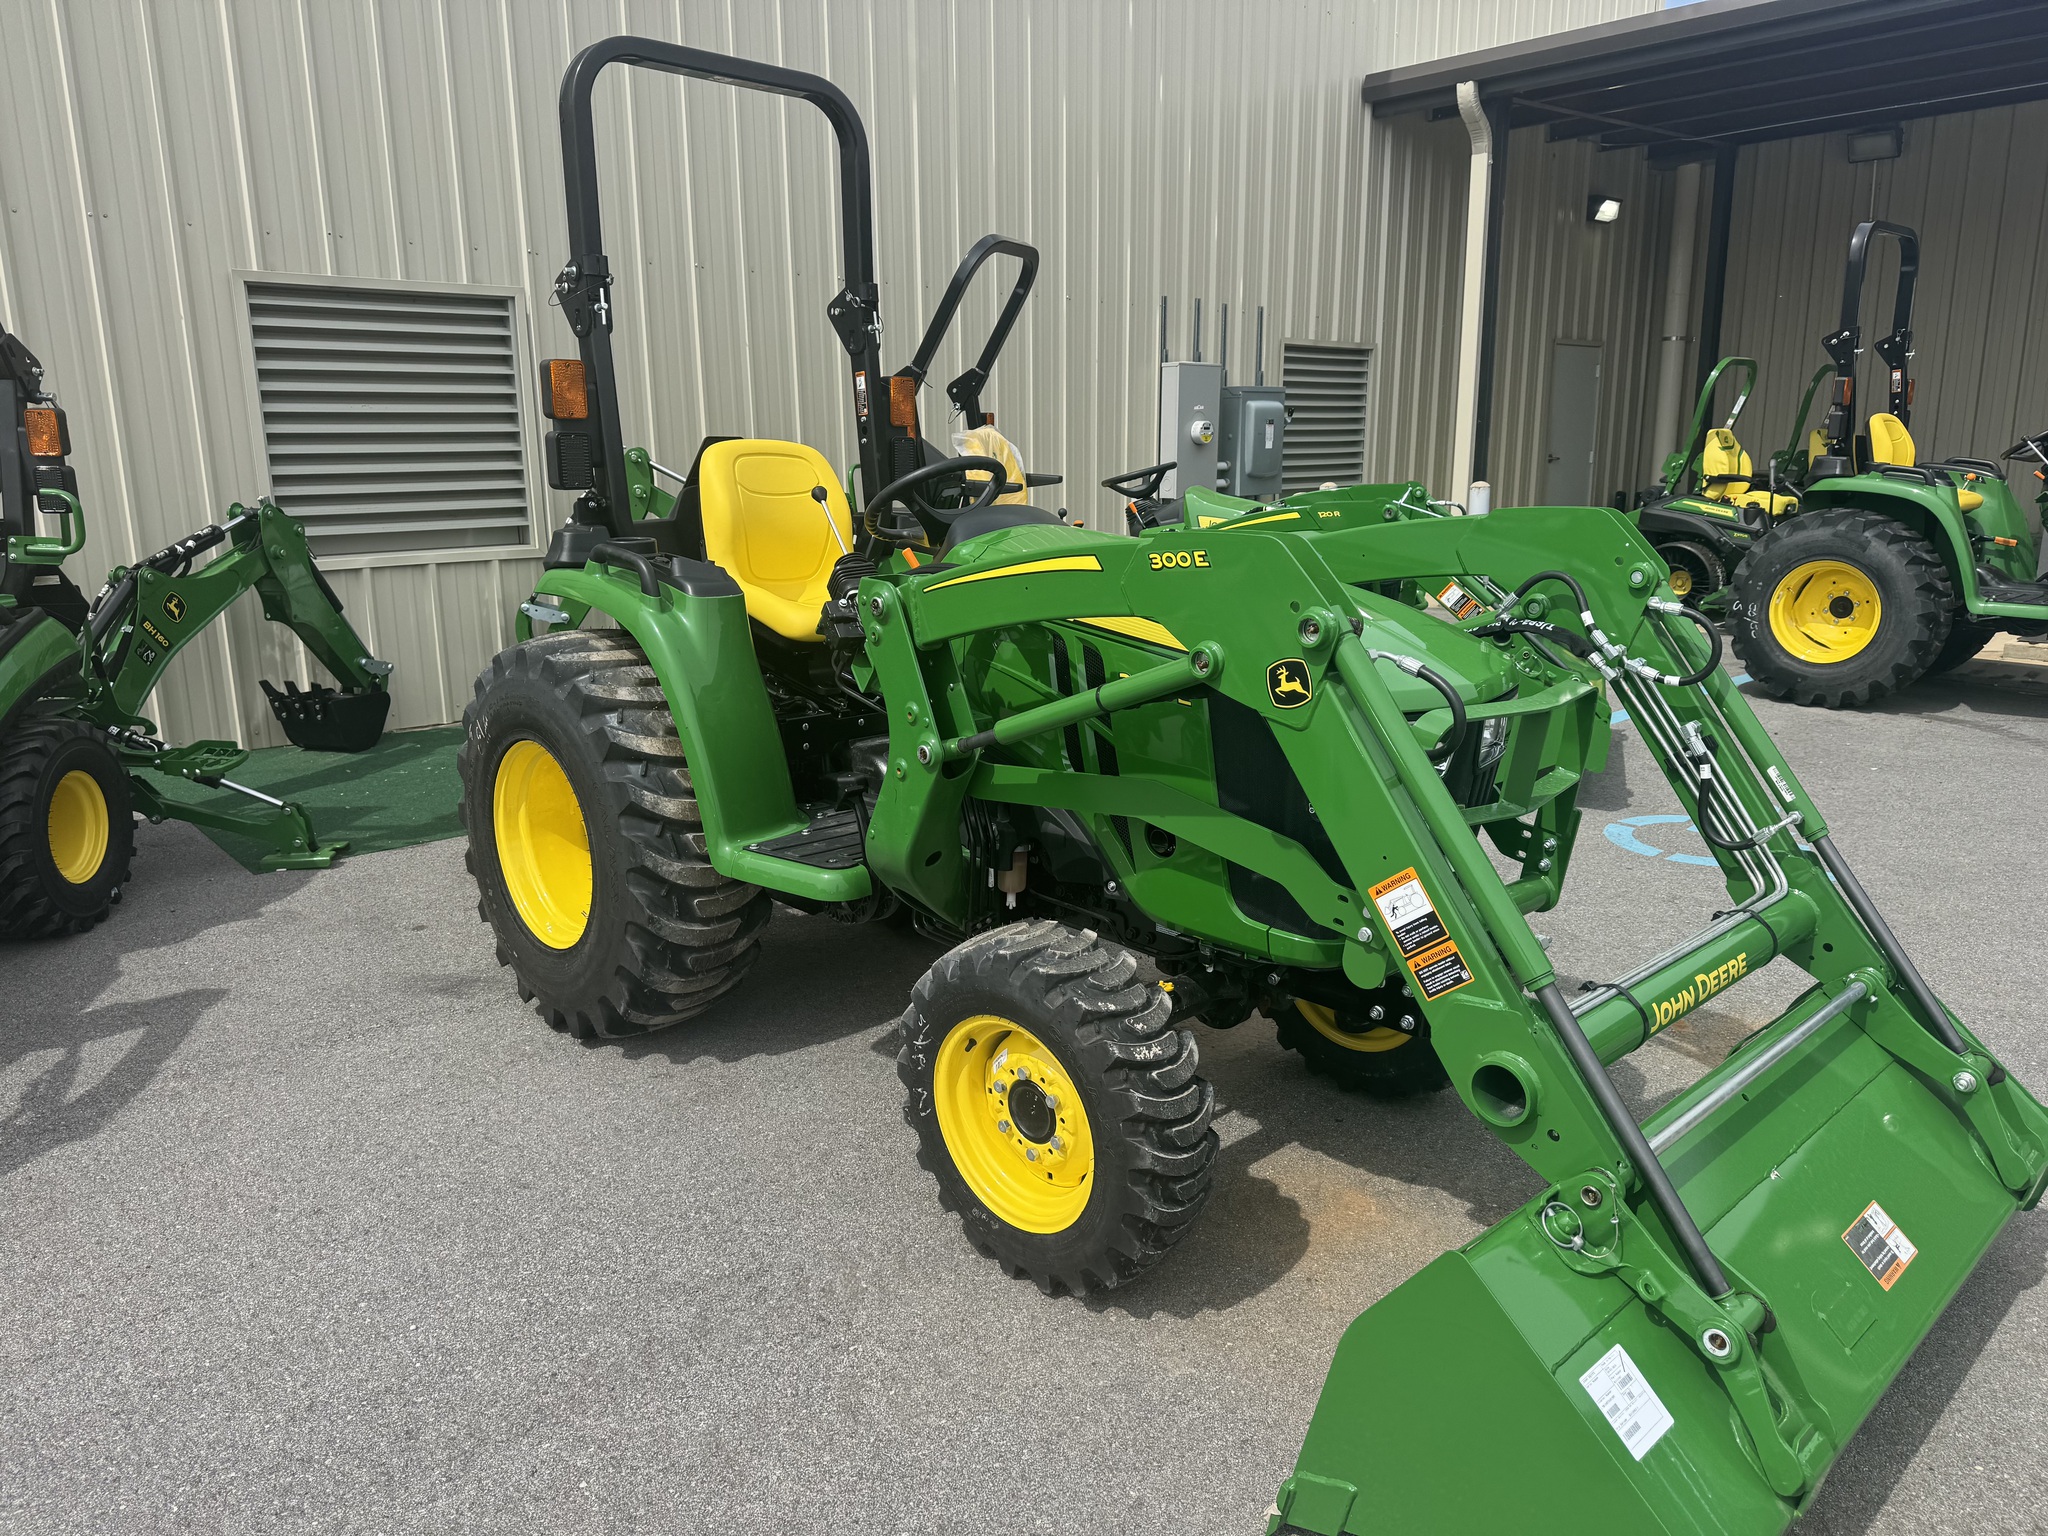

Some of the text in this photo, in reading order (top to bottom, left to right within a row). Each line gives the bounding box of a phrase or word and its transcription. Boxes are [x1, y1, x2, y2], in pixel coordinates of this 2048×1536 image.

[1317, 511, 1333, 519] 120
[1149, 550, 1211, 571] 300 E
[142, 620, 169, 647] BH 160
[1381, 872, 1411, 892] WARNING
[1421, 946, 1452, 964] WARNING
[1650, 952, 1748, 1034] JOHN DEERE
